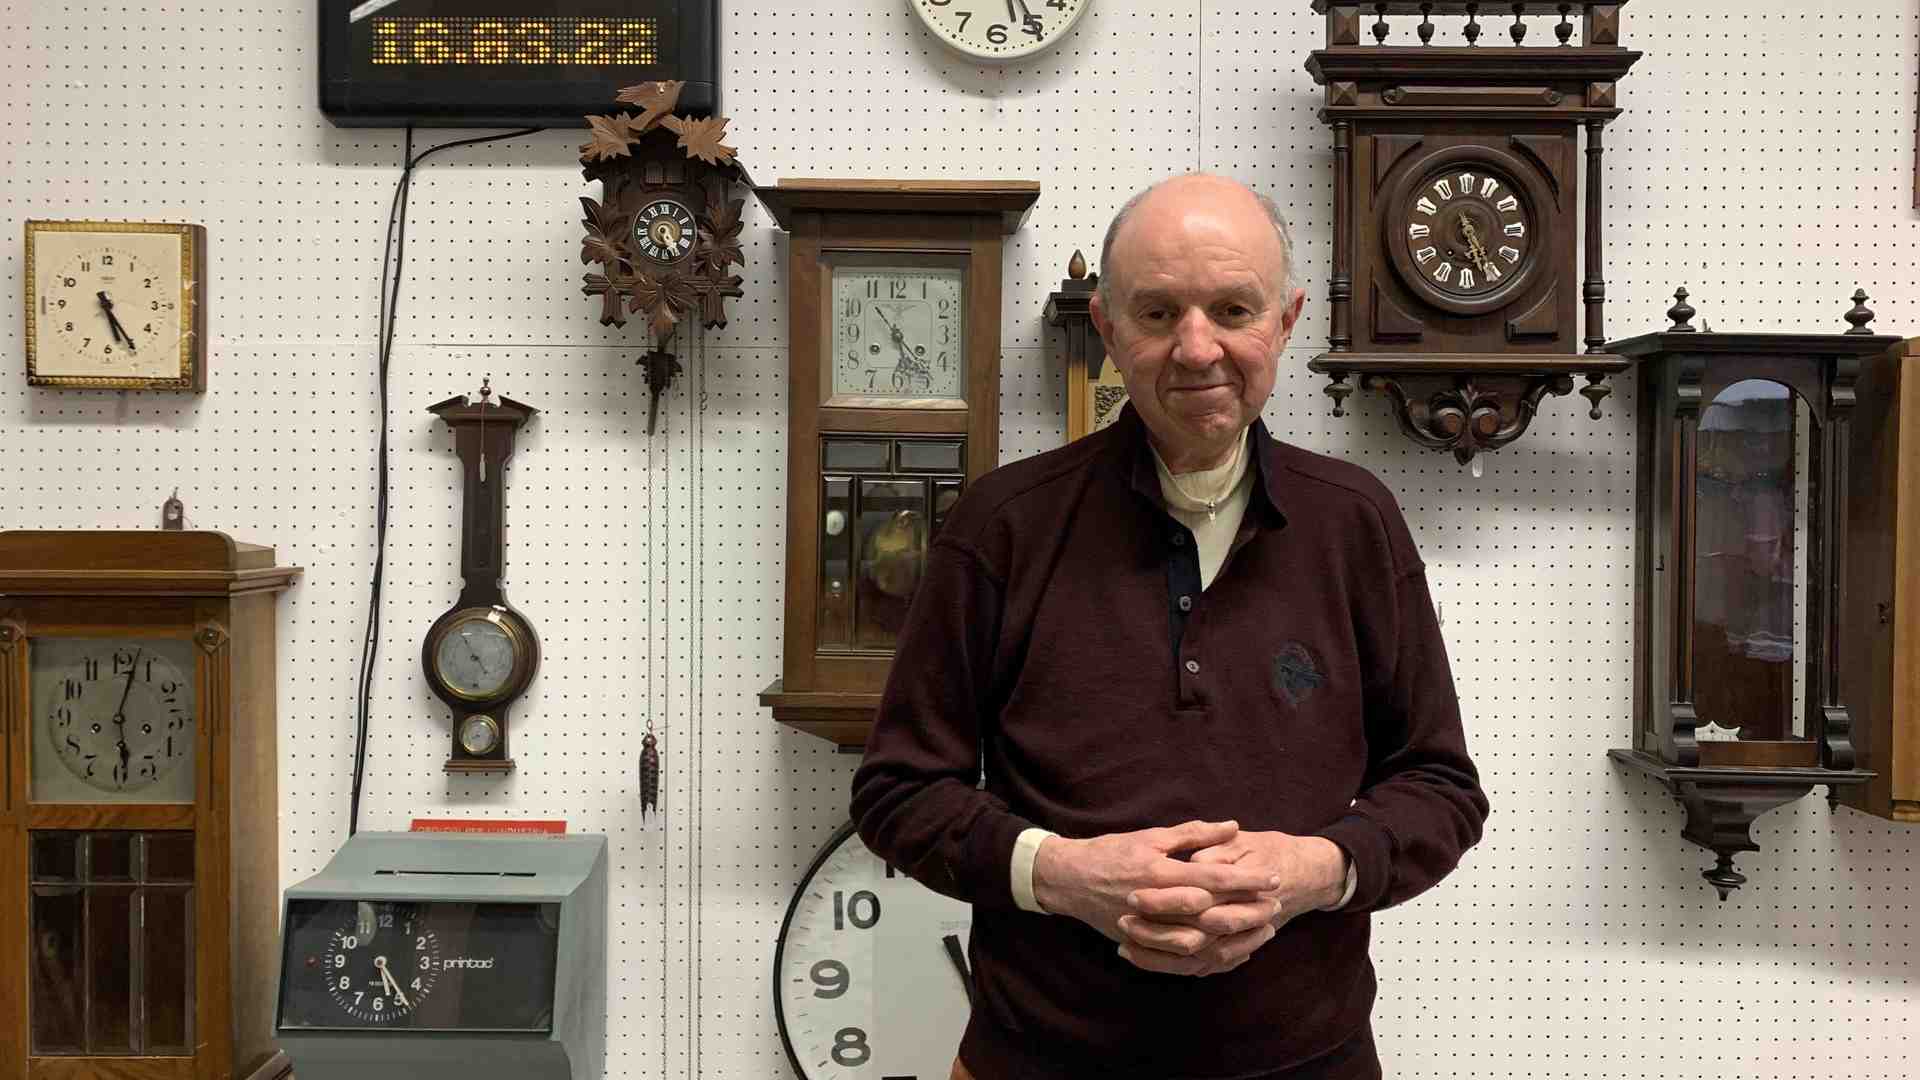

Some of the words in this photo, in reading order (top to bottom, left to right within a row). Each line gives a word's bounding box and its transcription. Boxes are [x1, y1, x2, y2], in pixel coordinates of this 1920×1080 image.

[955, 11, 972, 33] 7
[1021, 14, 1043, 35] 5
[986, 24, 1008, 44] 6
[81, 262, 90, 272] 11
[102, 255, 113, 265] 12
[130, 262, 134, 272] 1
[63, 278, 76, 287] 10
[144, 278, 151, 288] 2
[866, 279, 878, 298] 11
[889, 279, 906, 299] 12
[921, 280, 927, 299] 1
[57, 299, 66, 309] 9
[151, 301, 159, 311] 3
[845, 298, 861, 318] 10
[938, 298, 949, 319] 2
[65, 322, 73, 332] 8
[143, 323, 151, 333] 4
[847, 323, 859, 343] 9
[937, 324, 949, 345] 3
[83, 338, 91, 347] 7
[104, 344, 112, 354] 6
[847, 350, 859, 370] 8
[936, 351, 953, 372] 4
[865, 369, 877, 388] 7
[833, 890, 881, 930] 10
[359, 922, 370, 934] 11
[378, 914, 393, 928] 12
[404, 921, 411, 935] 1
[341, 935, 357, 949] 10
[416, 936, 427, 950] 2
[335, 955, 345, 968] 9
[420, 956, 430, 970] 3
[339, 976, 350, 989] 8
[411, 977, 421, 990] 4
[810, 959, 850, 999] 9
[354, 991, 365, 1005] 7
[373, 997, 383, 1011] 6
[831, 1027, 871, 1067] 8
